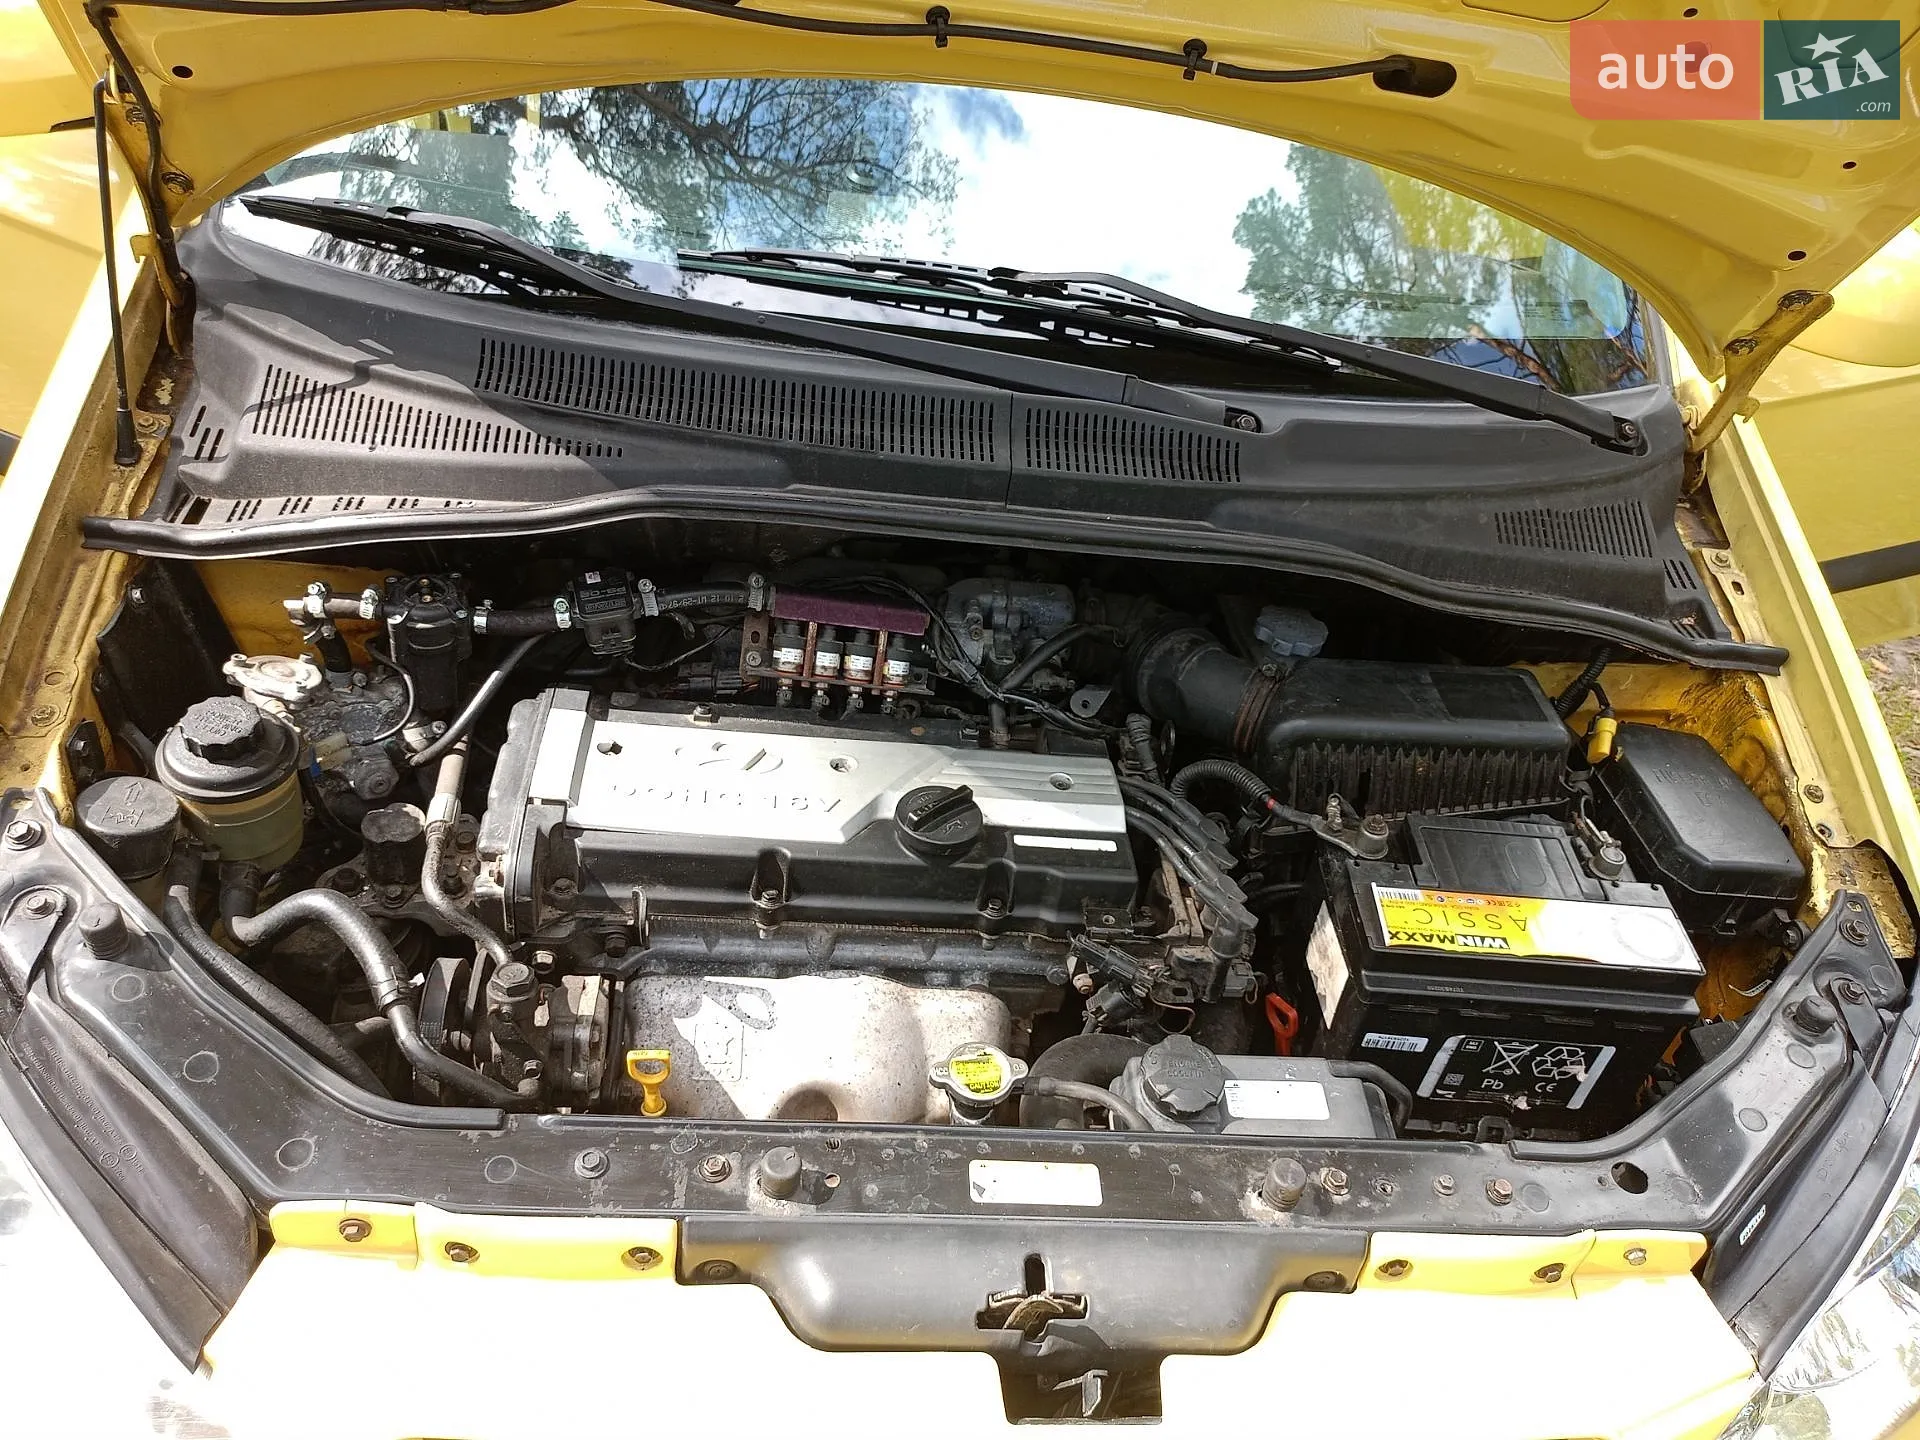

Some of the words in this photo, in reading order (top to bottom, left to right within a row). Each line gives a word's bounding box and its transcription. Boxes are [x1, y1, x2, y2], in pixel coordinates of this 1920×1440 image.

[1387, 930, 1511, 950] WINMAXX
[969, 1080, 1000, 1090] CAUTION
[1481, 1078, 1505, 1090] Pb
[1534, 1082, 1558, 1093] CE
